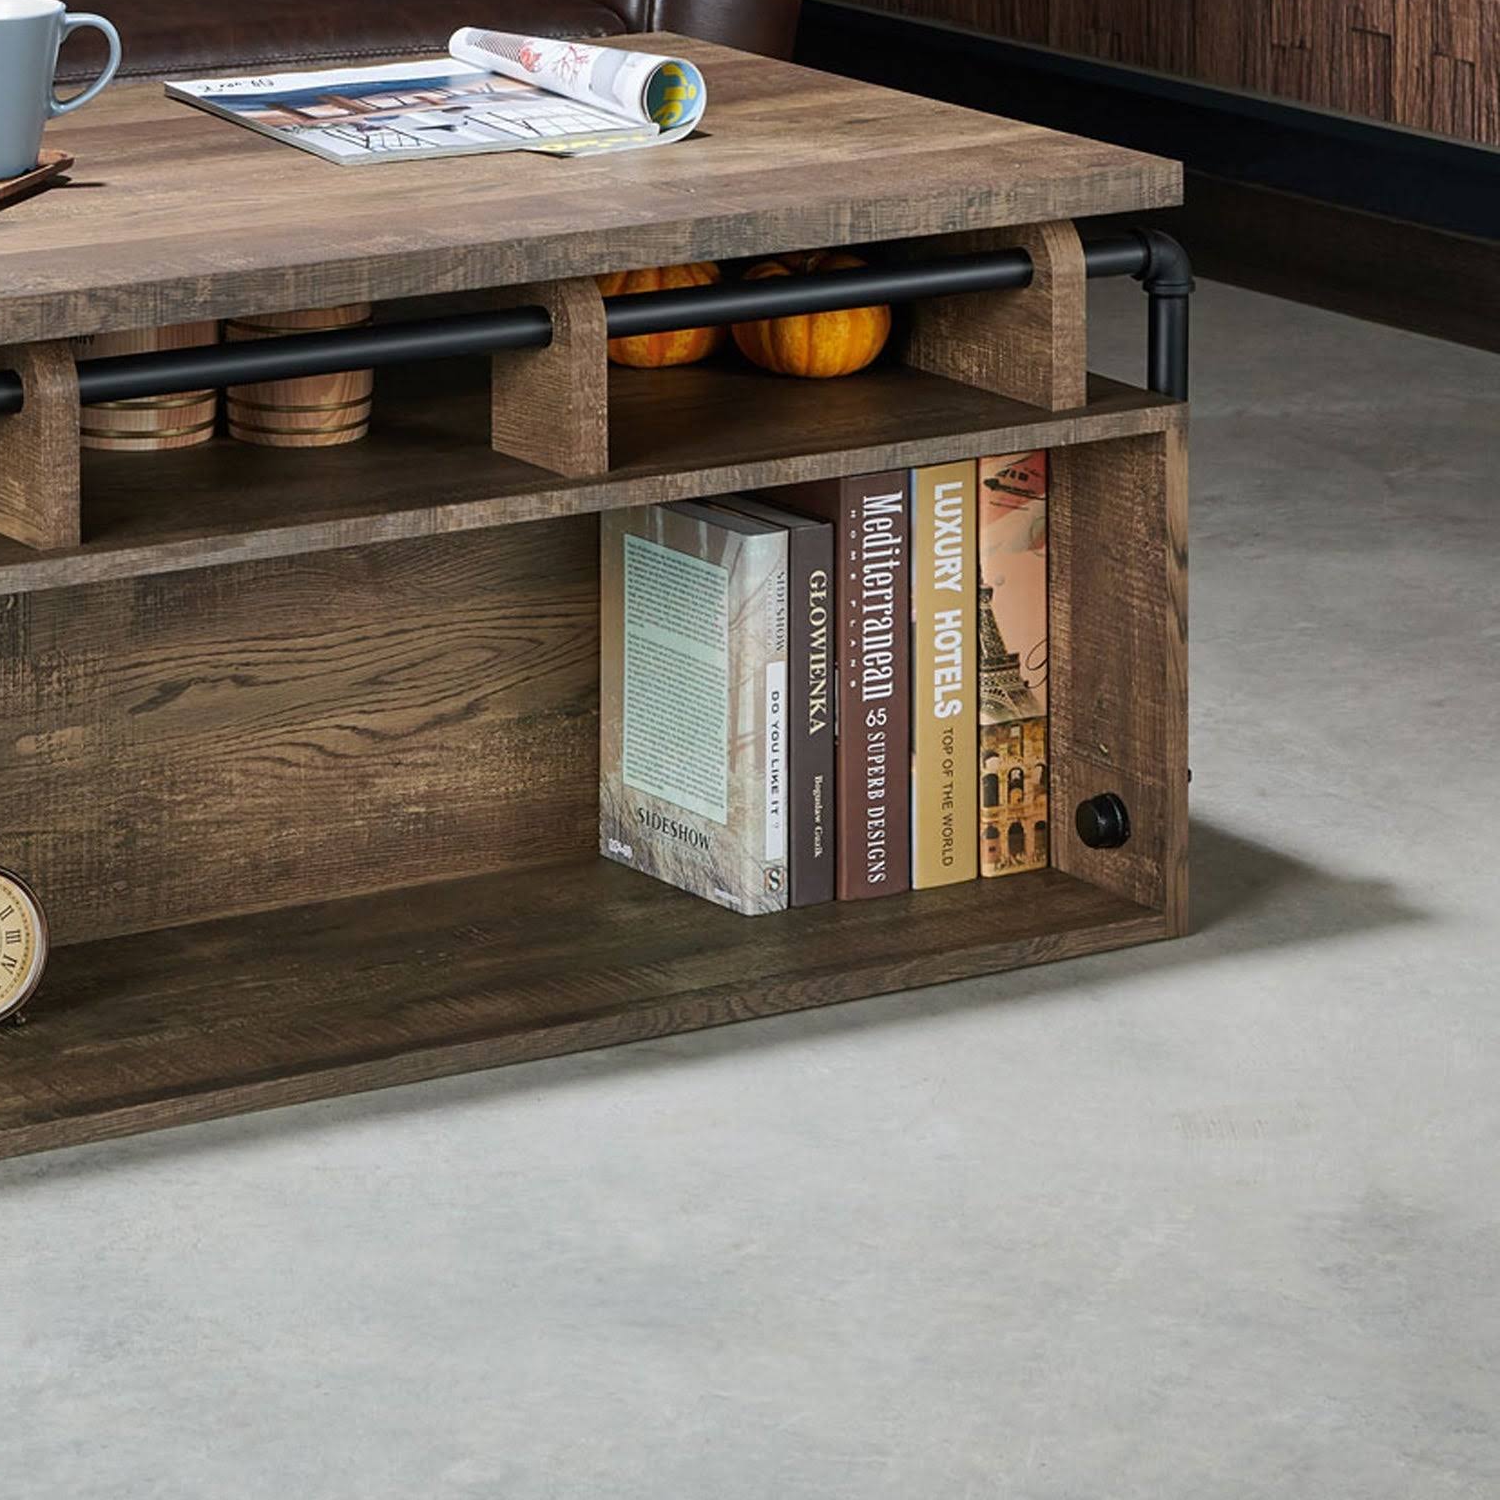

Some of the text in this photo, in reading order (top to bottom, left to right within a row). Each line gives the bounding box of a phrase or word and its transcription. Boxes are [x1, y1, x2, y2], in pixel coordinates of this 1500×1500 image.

[862, 491, 903, 703] Mediterranean
[933, 481, 963, 720] LUXURY HOTELS
[808, 569, 828, 735] GŁOWIENKA
[770, 690, 781, 714] DO
[770, 721, 781, 754] YOU
[770, 758, 781, 796] LIKE
[865, 707, 887, 884] 65 SUPERB DESIGNS
[941, 727, 954, 867] TOP OF THE WORLD
[636, 806, 712, 851] SIDESHOW
[770, 800, 781, 817] IT
[5, 929, 22, 944] III
